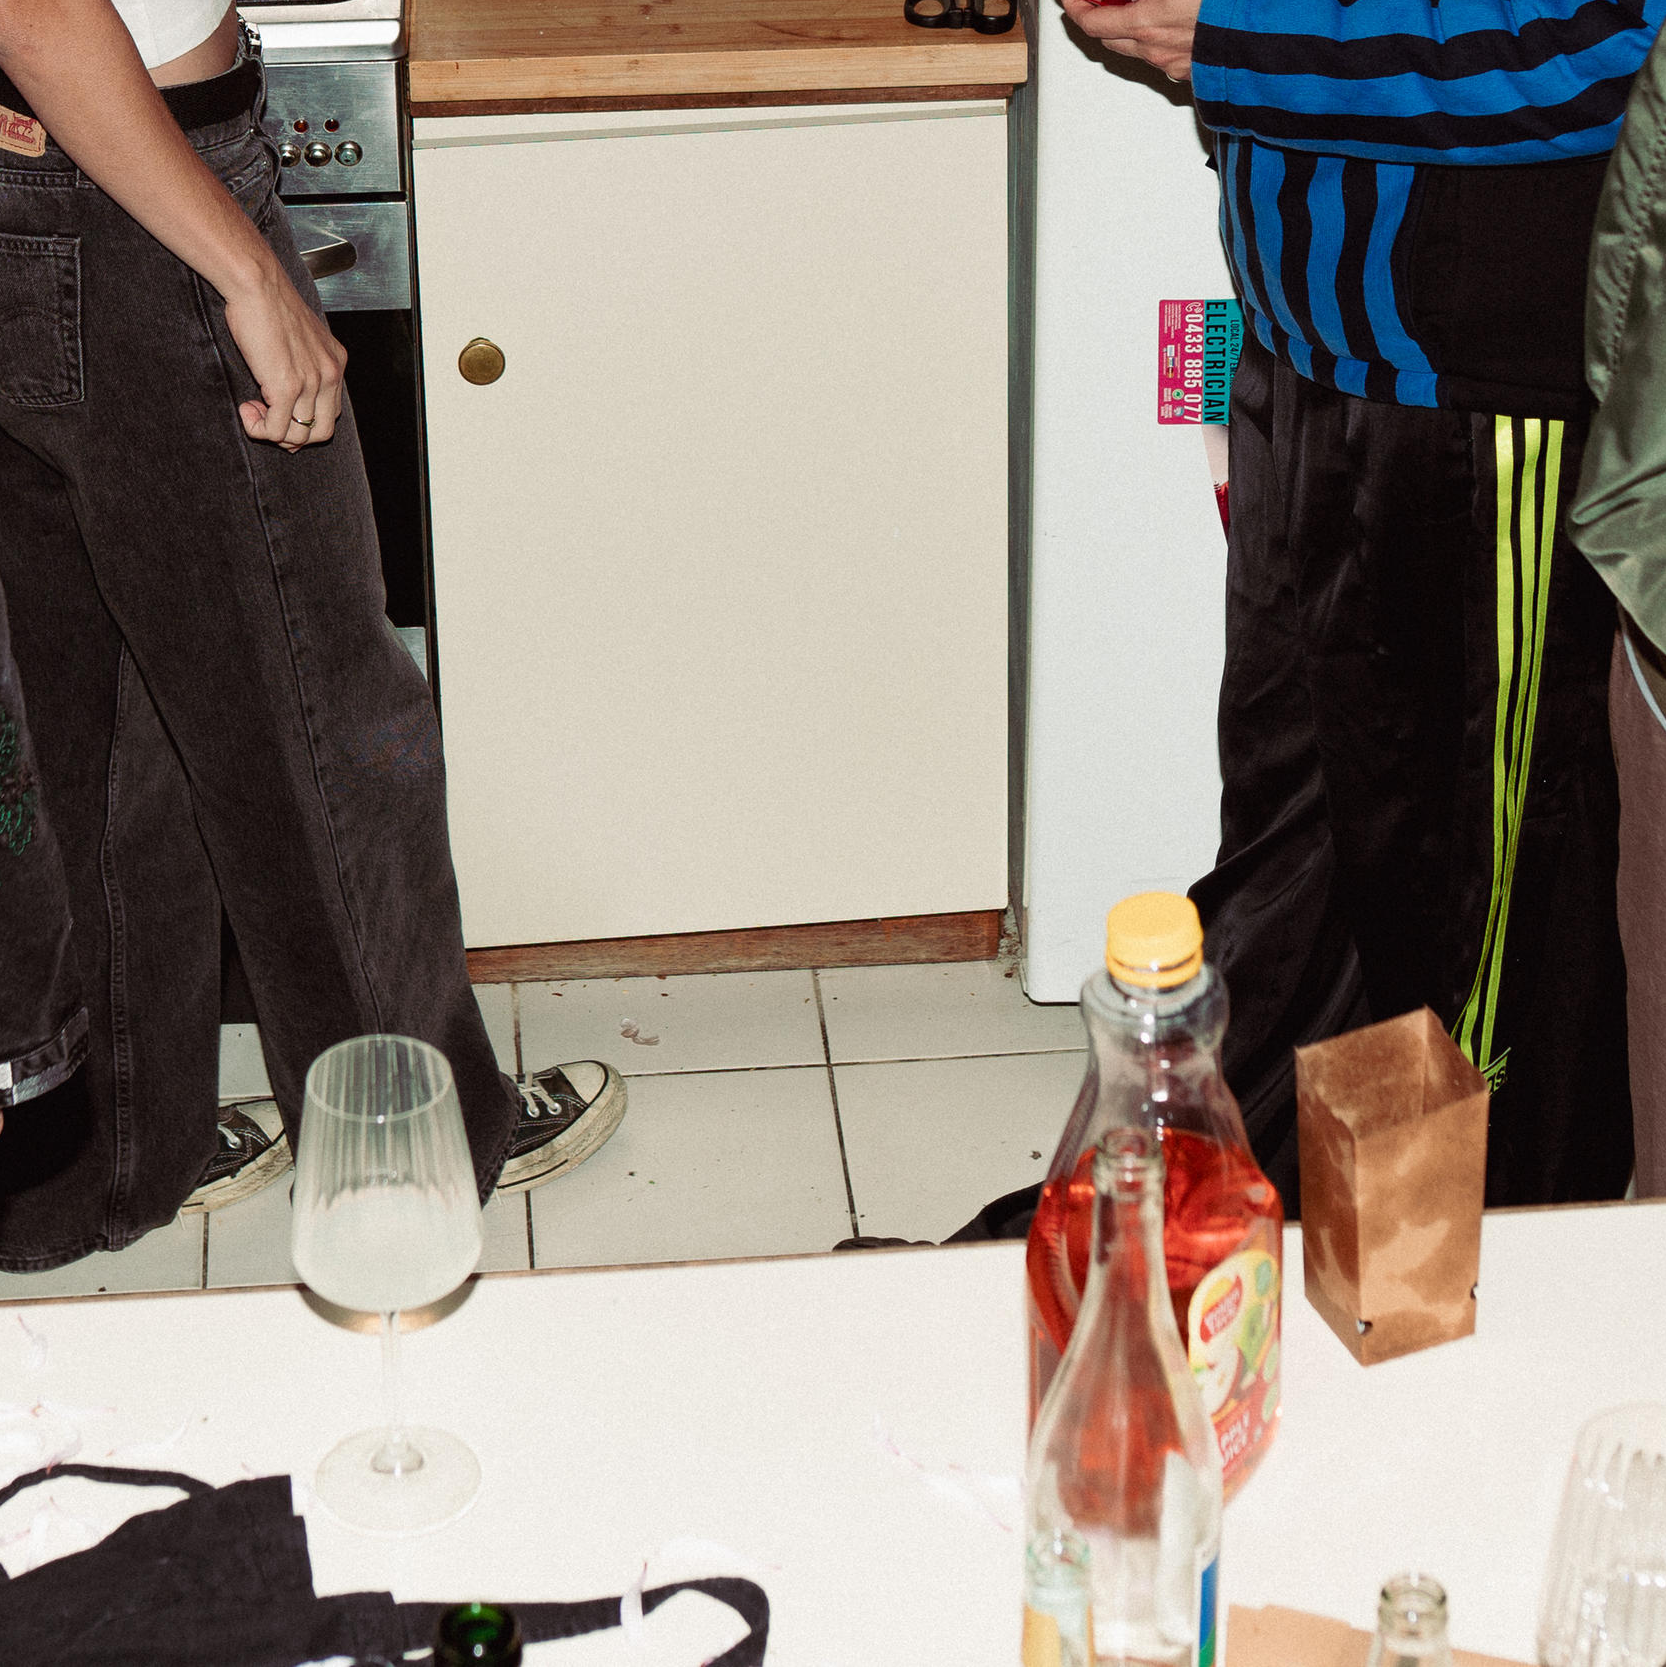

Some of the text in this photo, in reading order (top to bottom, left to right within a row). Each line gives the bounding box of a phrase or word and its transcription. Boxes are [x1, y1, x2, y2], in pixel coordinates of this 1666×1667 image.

[1183, 313, 1204, 423] 0433 885 077
[1204, 301, 1228, 422] ELECTRICIAN
[1229, 319, 1240, 342] LOCAL
